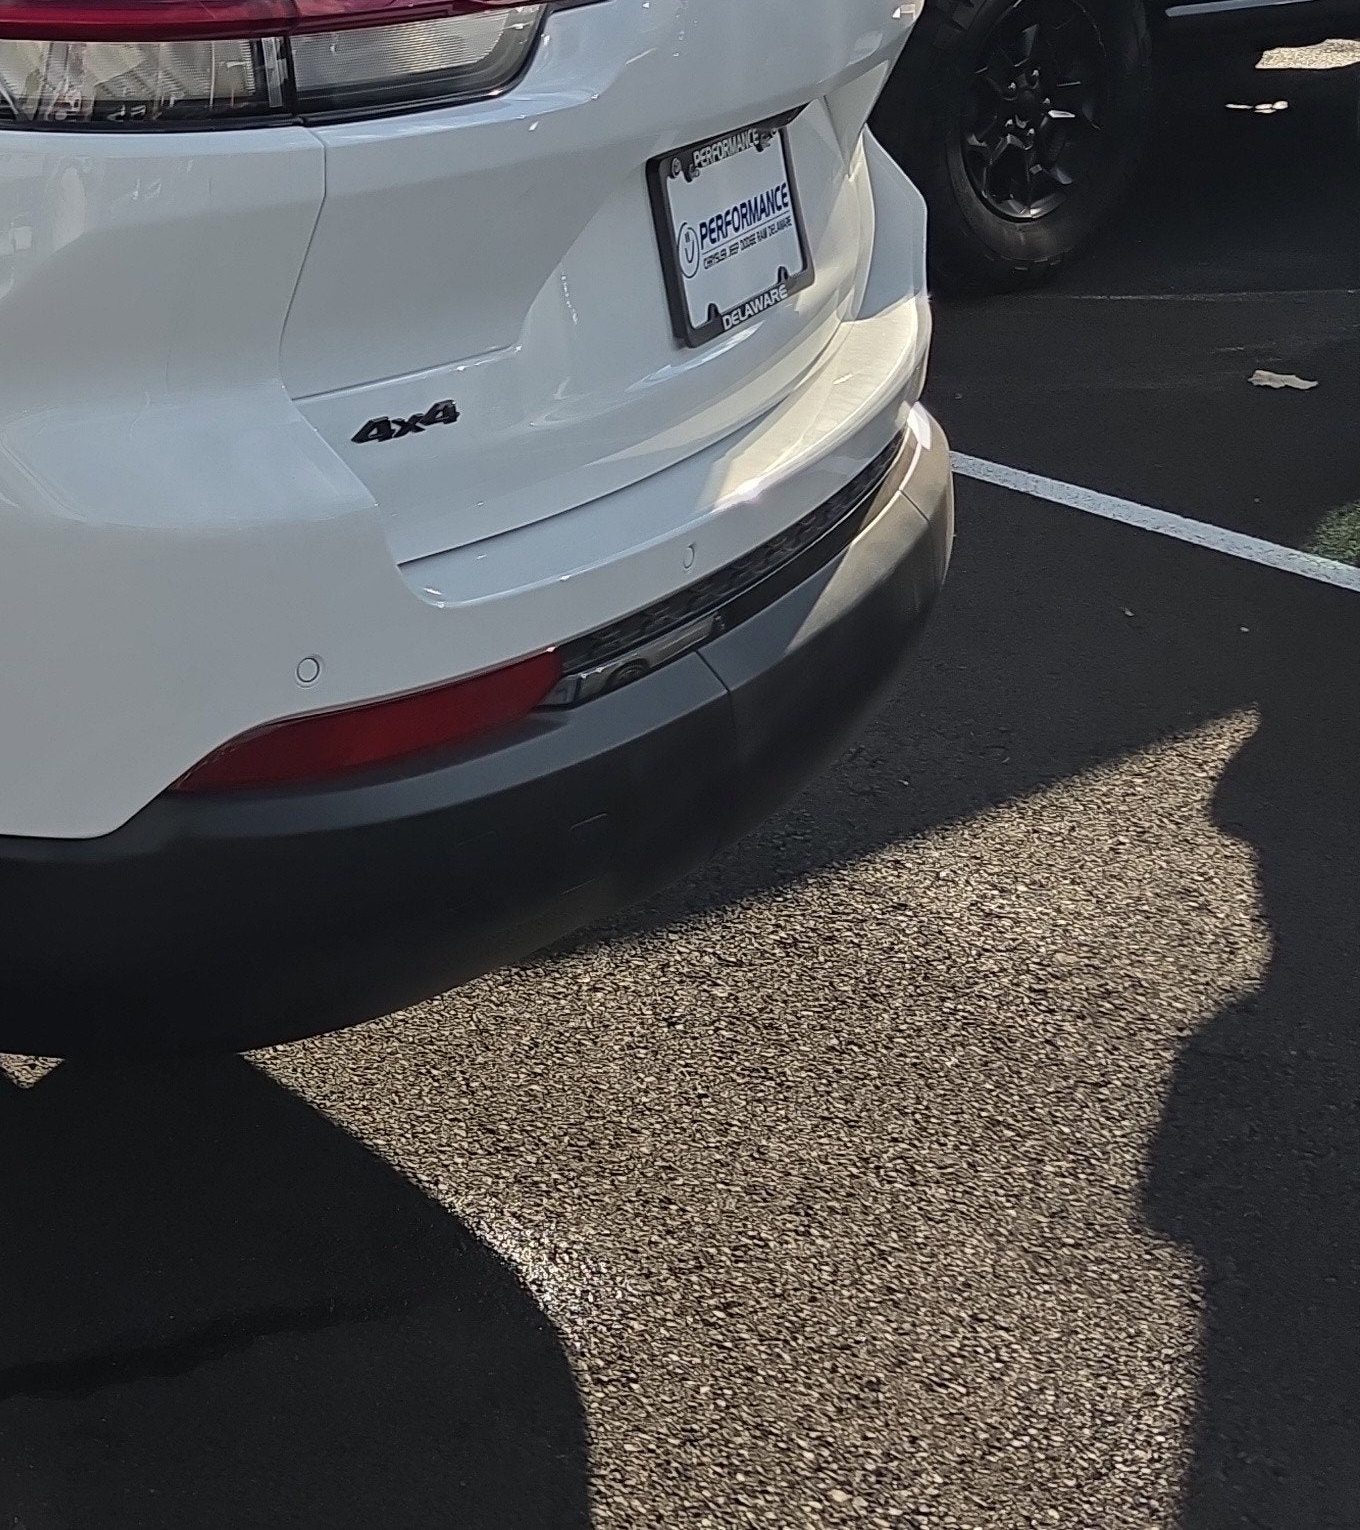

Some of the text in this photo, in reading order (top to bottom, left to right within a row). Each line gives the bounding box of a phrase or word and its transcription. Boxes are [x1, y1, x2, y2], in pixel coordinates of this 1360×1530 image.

[692, 128, 760, 168] PERFORMANCE
[699, 181, 790, 251] PERFORMANCE
[722, 283, 789, 331] DELAWARE
[350, 398, 461, 444] 4x4
